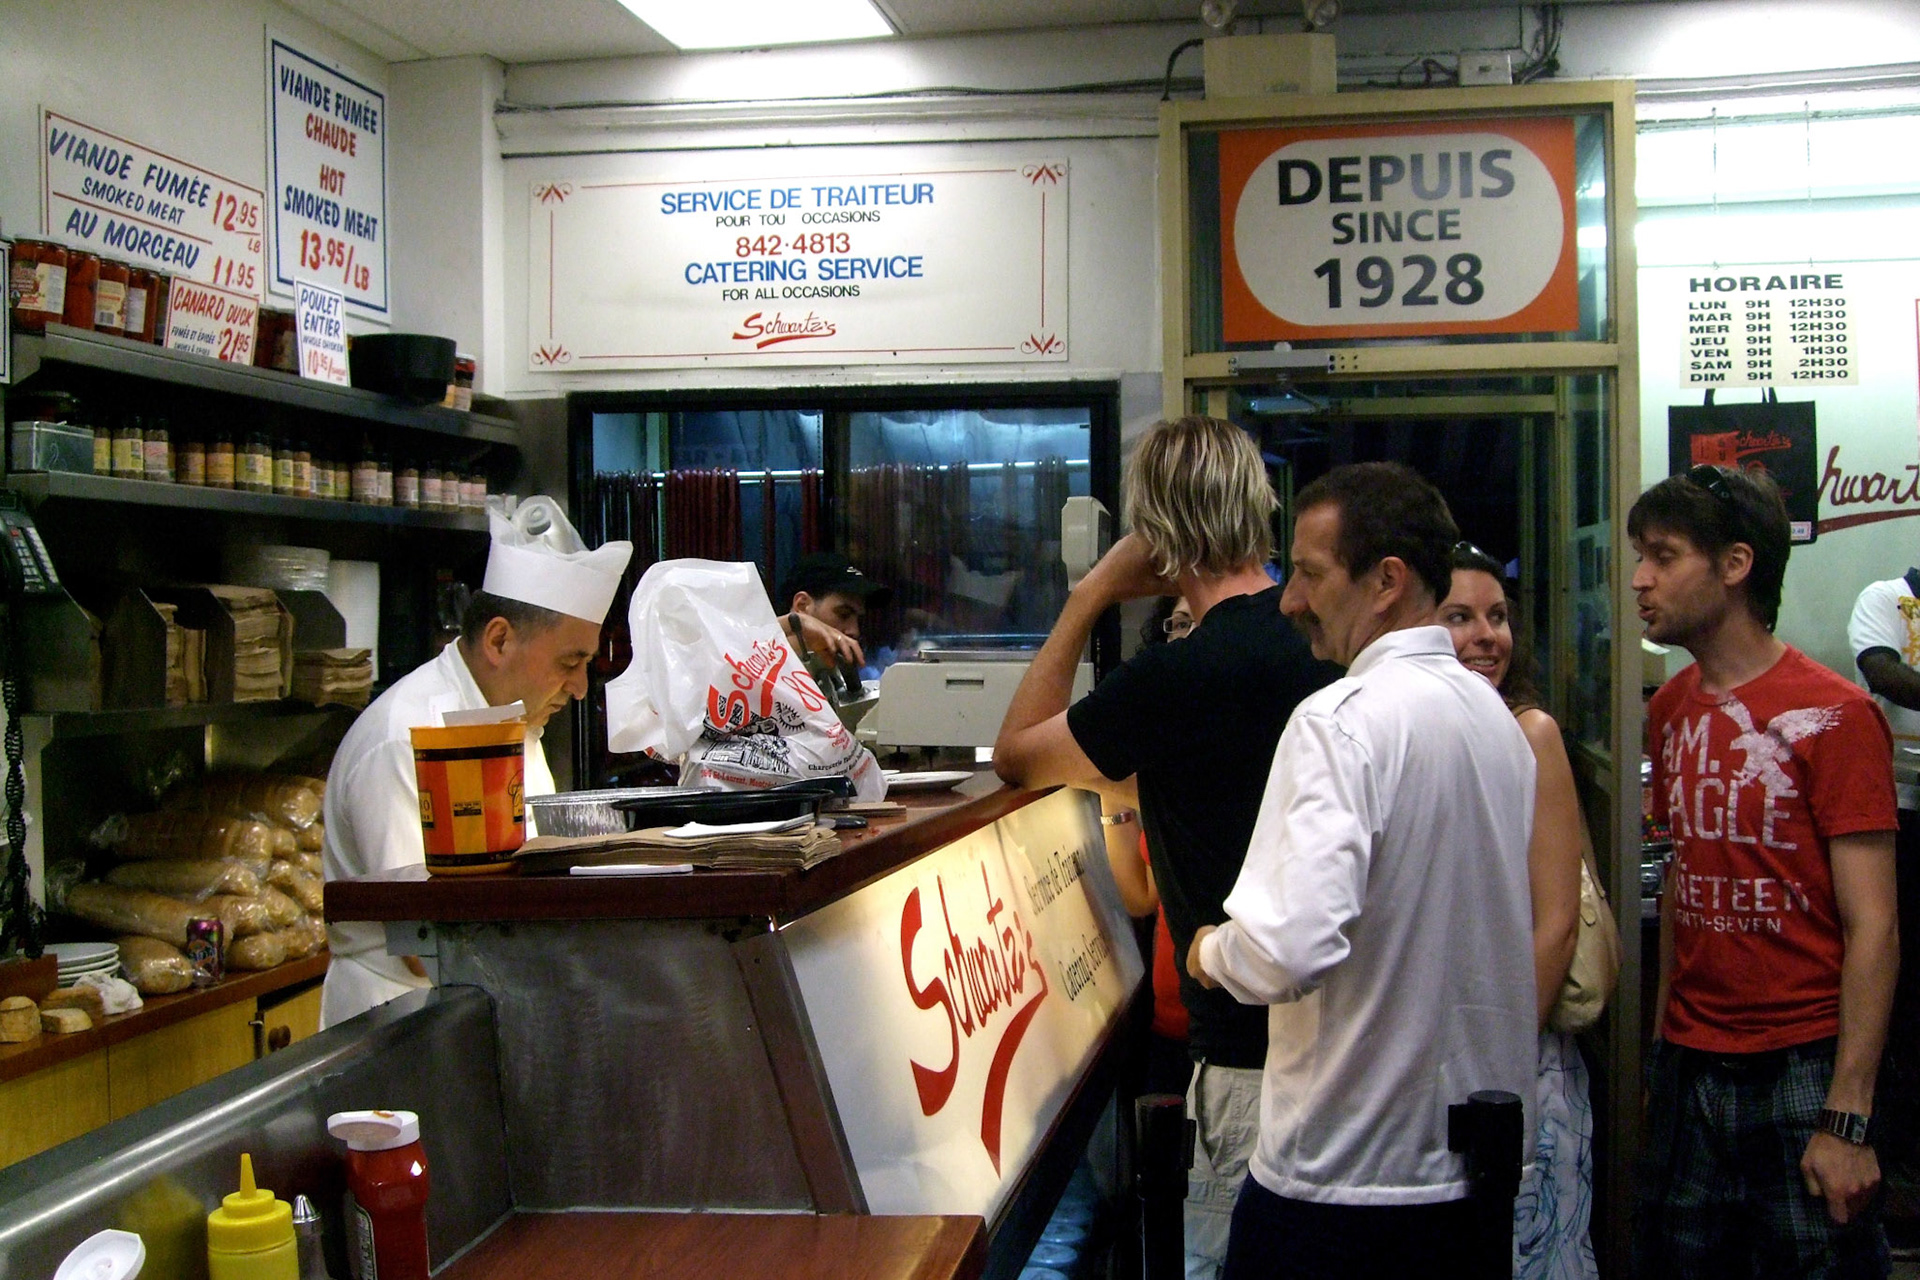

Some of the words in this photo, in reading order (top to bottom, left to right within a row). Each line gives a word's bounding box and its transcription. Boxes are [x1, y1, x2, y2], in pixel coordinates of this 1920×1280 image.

[281, 64, 330, 113] VIANDE
[335, 92, 378, 134] FUMÉE
[305, 112, 356, 157] CHAUDE
[50, 127, 133, 180] VIANDE
[143, 163, 211, 207] FUMÉE
[319, 163, 345, 197] HOT
[1277, 149, 1516, 206] DEPUIS
[82, 176, 144, 212] SMOKED
[147, 200, 185, 225] MEAT
[213, 190, 258, 231] 12.95
[284, 184, 340, 228] SMOKED
[344, 206, 378, 242] MEAT
[660, 189, 761, 215] SERVICE
[770, 188, 802, 209] DE
[811, 183, 934, 207] TRAITEUR
[715, 215, 751, 227] POUR
[759, 214, 786, 227] TOU
[801, 210, 881, 224] OCCASIONS
[1332, 208, 1461, 245] SINCE
[66, 208, 98, 239] AU
[103, 219, 199, 269] MORCEAU
[248, 238, 261, 253] LB
[213, 255, 255, 288] 11.95
[684, 259, 807, 285] CATERING
[818, 255, 923, 280] SERVICE
[1313, 252, 1485, 309] 1928
[1690, 274, 1843, 293] HORAIRE
[174, 286, 225, 320] CANARD
[226, 304, 254, 327] DUCK
[300, 288, 339, 316] POULET
[722, 288, 748, 301] FOR
[755, 287, 778, 299] ALL
[782, 285, 860, 299] OCCASIONS
[1689, 301, 1726, 310] LUN
[1745, 300, 1770, 309] 9H
[1789, 298, 1846, 308] 12H30
[303, 311, 340, 338] ENTIER
[732, 311, 836, 346] Schwartz's
[1689, 312, 1732, 322] MAR
[1746, 312, 1771, 320] 9H
[1789, 310, 1846, 319] 12H30
[1690, 324, 1730, 334] MER
[1746, 323, 1771, 332] 9H
[1789, 322, 1847, 331] 12H30
[1690, 336, 1726, 346] JEU
[1746, 335, 1772, 344] 9H
[1790, 334, 1847, 343] 12H30
[1690, 349, 1729, 358] VEN
[1746, 347, 1772, 356] 9H
[1802, 346, 1848, 355] 1H30
[1690, 360, 1732, 370] SAM
[1747, 359, 1772, 368] 9H
[1799, 358, 1848, 367] 2H30
[1690, 373, 1725, 382] DIM
[1747, 371, 1772, 380] 9H
[1791, 370, 1848, 379] 12H30
[1662, 712, 1720, 775] AM.
[1666, 776, 1799, 850] AGLE
[1675, 874, 1810, 913] NETEEN
[900, 861, 1049, 1130] Schwartz's
